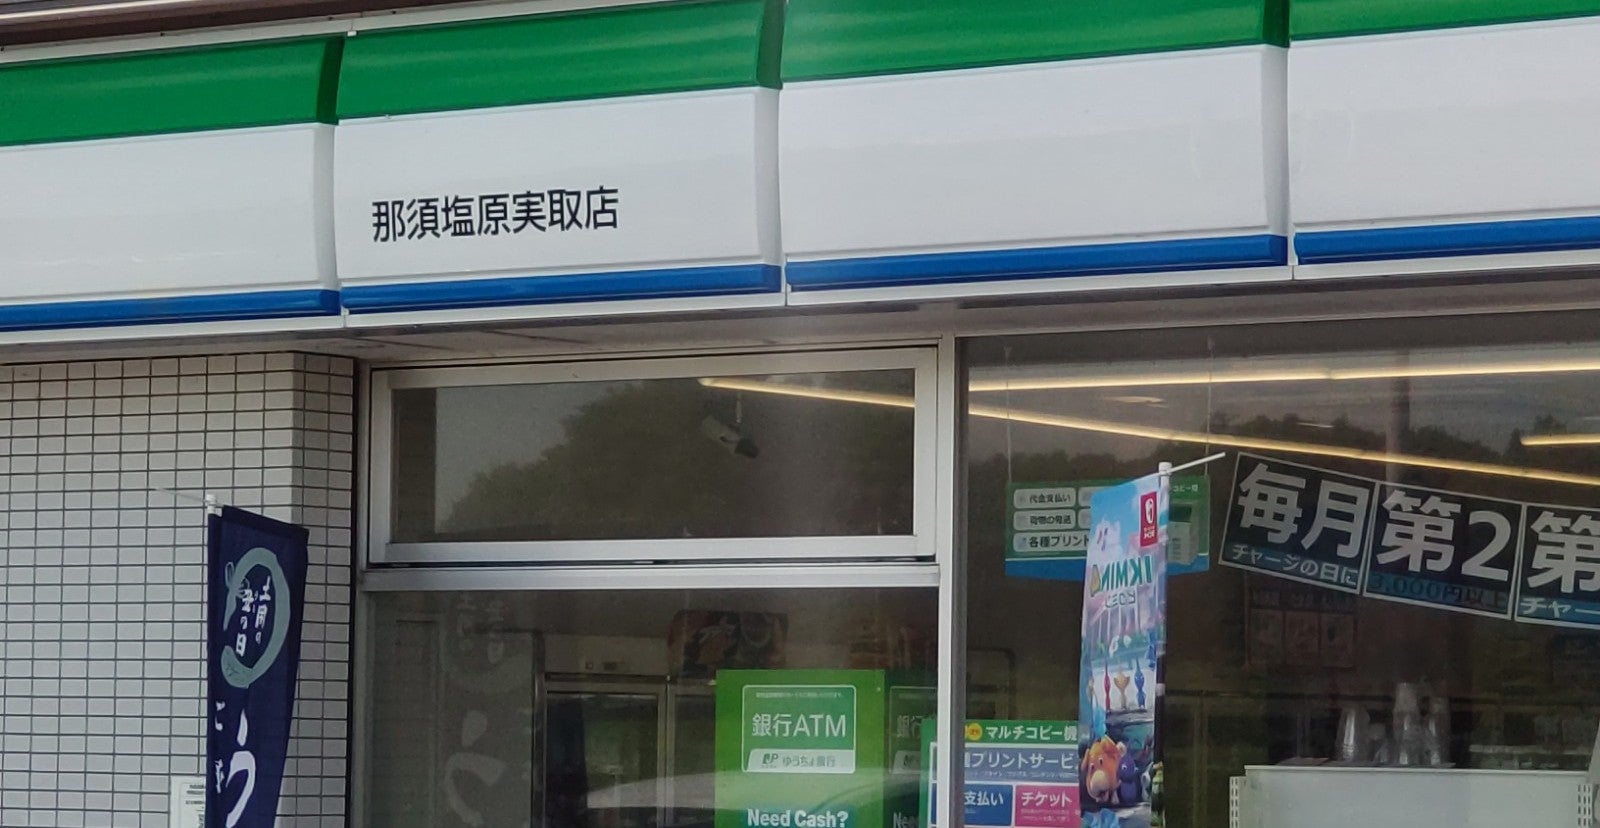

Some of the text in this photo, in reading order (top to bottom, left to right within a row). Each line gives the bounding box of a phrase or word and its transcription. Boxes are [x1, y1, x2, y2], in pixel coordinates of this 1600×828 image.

[371, 185, 619, 242] 那須塩原実取店
[1237, 462, 1600, 593] 毎月 第2 第
[1231, 544, 1357, 587] チャージの日に
[751, 712, 846, 738] 銀行ATM
[985, 725, 1078, 742] マルチコピー機
[964, 752, 1079, 770] プリントサービ
[964, 791, 1004, 807] 支払い
[1021, 791, 1073, 808] チケット
[748, 808, 849, 828] Need Cash?
